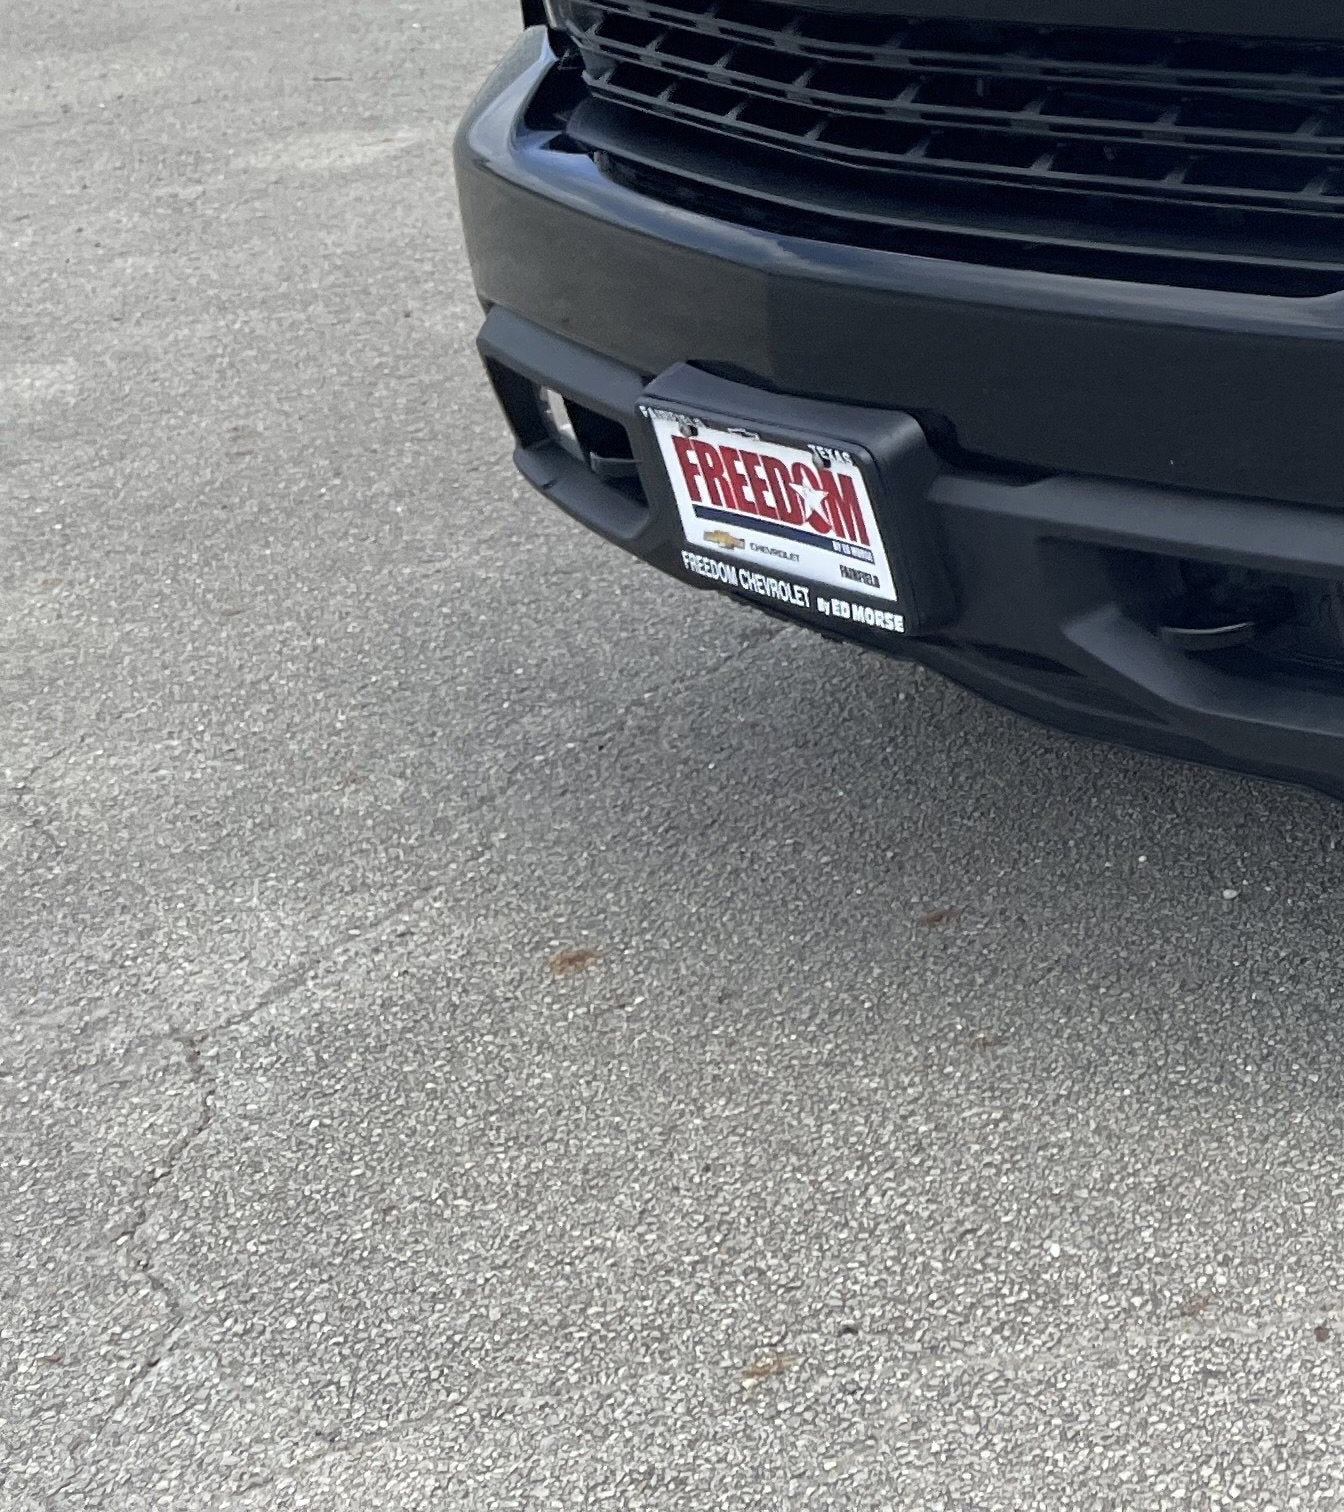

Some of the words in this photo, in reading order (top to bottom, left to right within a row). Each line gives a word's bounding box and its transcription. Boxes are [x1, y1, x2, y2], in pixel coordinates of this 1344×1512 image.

[807, 443, 852, 467] TEXAS
[671, 434, 871, 547] FREEDOM
[749, 542, 800, 562] CHEVROLET
[681, 549, 739, 587] FREEDOM
[738, 570, 811, 608] CHEVROLET
[831, 598, 850, 619] ED
[850, 608, 905, 633] MORSE
